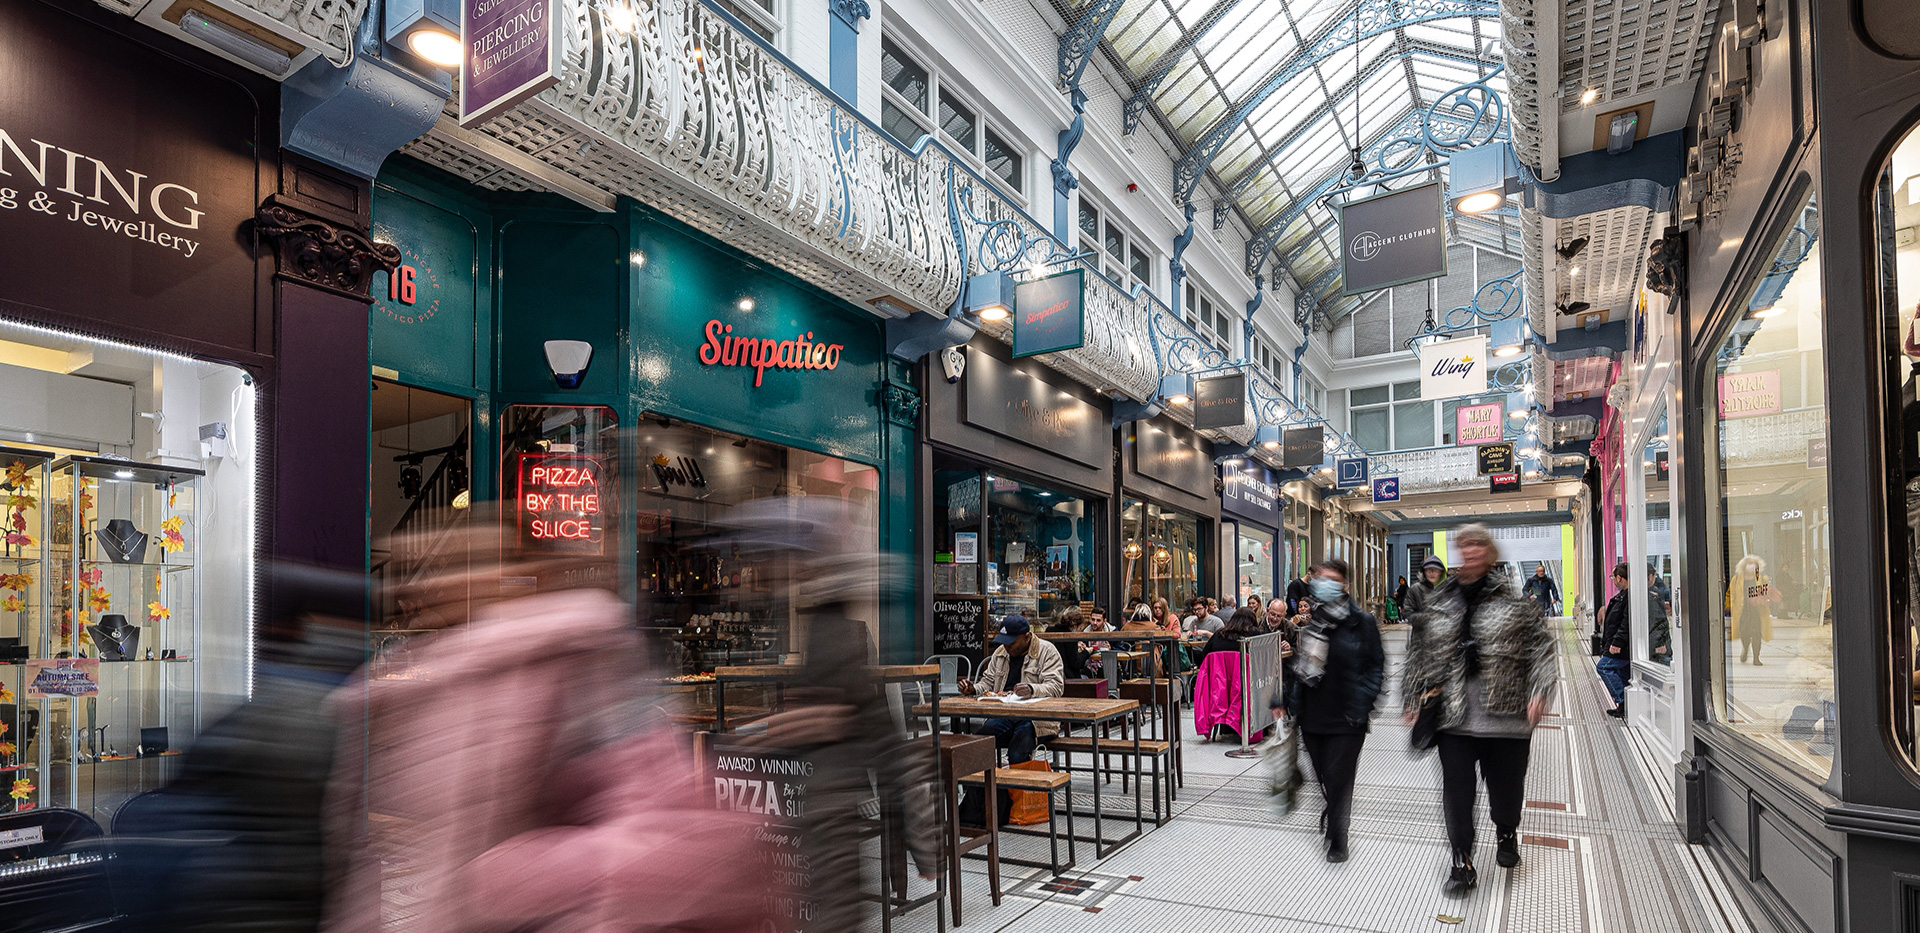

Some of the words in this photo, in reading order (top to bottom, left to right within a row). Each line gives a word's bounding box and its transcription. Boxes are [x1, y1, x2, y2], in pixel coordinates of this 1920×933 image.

[473, 2, 543, 60] PIERCING
[473, 64, 481, 78] &
[482, 26, 542, 73] JEWELLERY
[28, 191, 57, 215] &
[67, 200, 200, 258] Jewellery
[1368, 236, 1396, 249] ACCENT
[1399, 227, 1436, 242] CLOTHING
[405, 249, 440, 289] ARCADE
[391, 264, 417, 305] 16
[372, 296, 415, 325] PATICO
[418, 299, 441, 323] PIZZA
[1025, 300, 1070, 325] Simpatico
[700, 319, 845, 388] Simpatico
[1431, 356, 1475, 379] Wing
[1467, 408, 1492, 424] MARY
[1461, 423, 1499, 441] SHORTLE
[531, 467, 595, 485] PIZZA
[526, 493, 553, 511] BY
[557, 493, 598, 511] THE
[531, 520, 590, 538] SLICE
[717, 624, 745, 632] FRESH
[36, 673, 69, 682] AUTUMN
[717, 755, 756, 773] AWARD
[760, 758, 815, 777] WINNING
[714, 776, 782, 817] PIZZA
[782, 782, 795, 800] By
[754, 826, 789, 848] Range
[771, 869, 812, 889] SPIRITS
[799, 899, 822, 923] FOR
